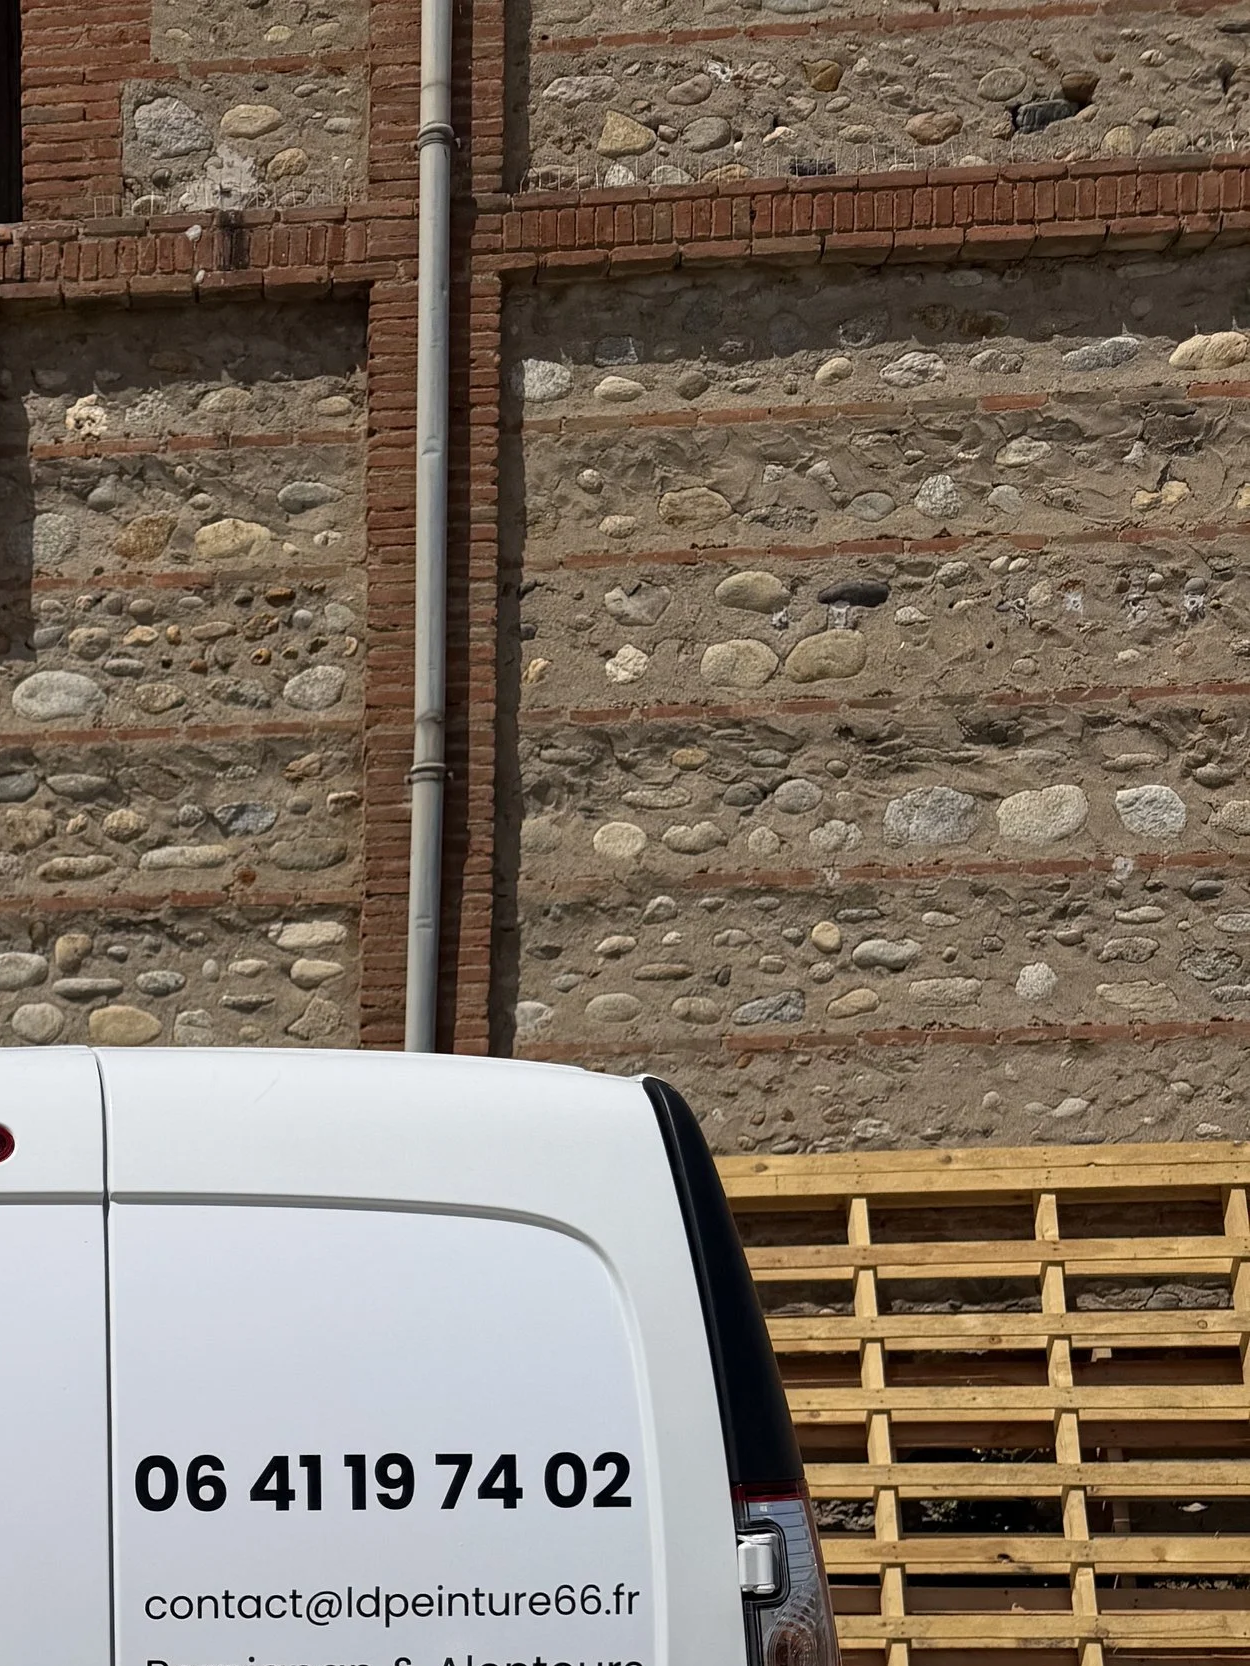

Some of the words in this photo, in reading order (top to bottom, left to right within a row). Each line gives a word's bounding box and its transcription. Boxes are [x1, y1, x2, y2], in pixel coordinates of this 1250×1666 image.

[134, 1454, 227, 1512] 06
[249, 1454, 322, 1511] 41
[343, 1452, 415, 1511] 19
[434, 1453, 523, 1510] 74
[544, 1451, 632, 1509] 02
[144, 1583, 641, 1627] contact@ldpeinture66.fr
